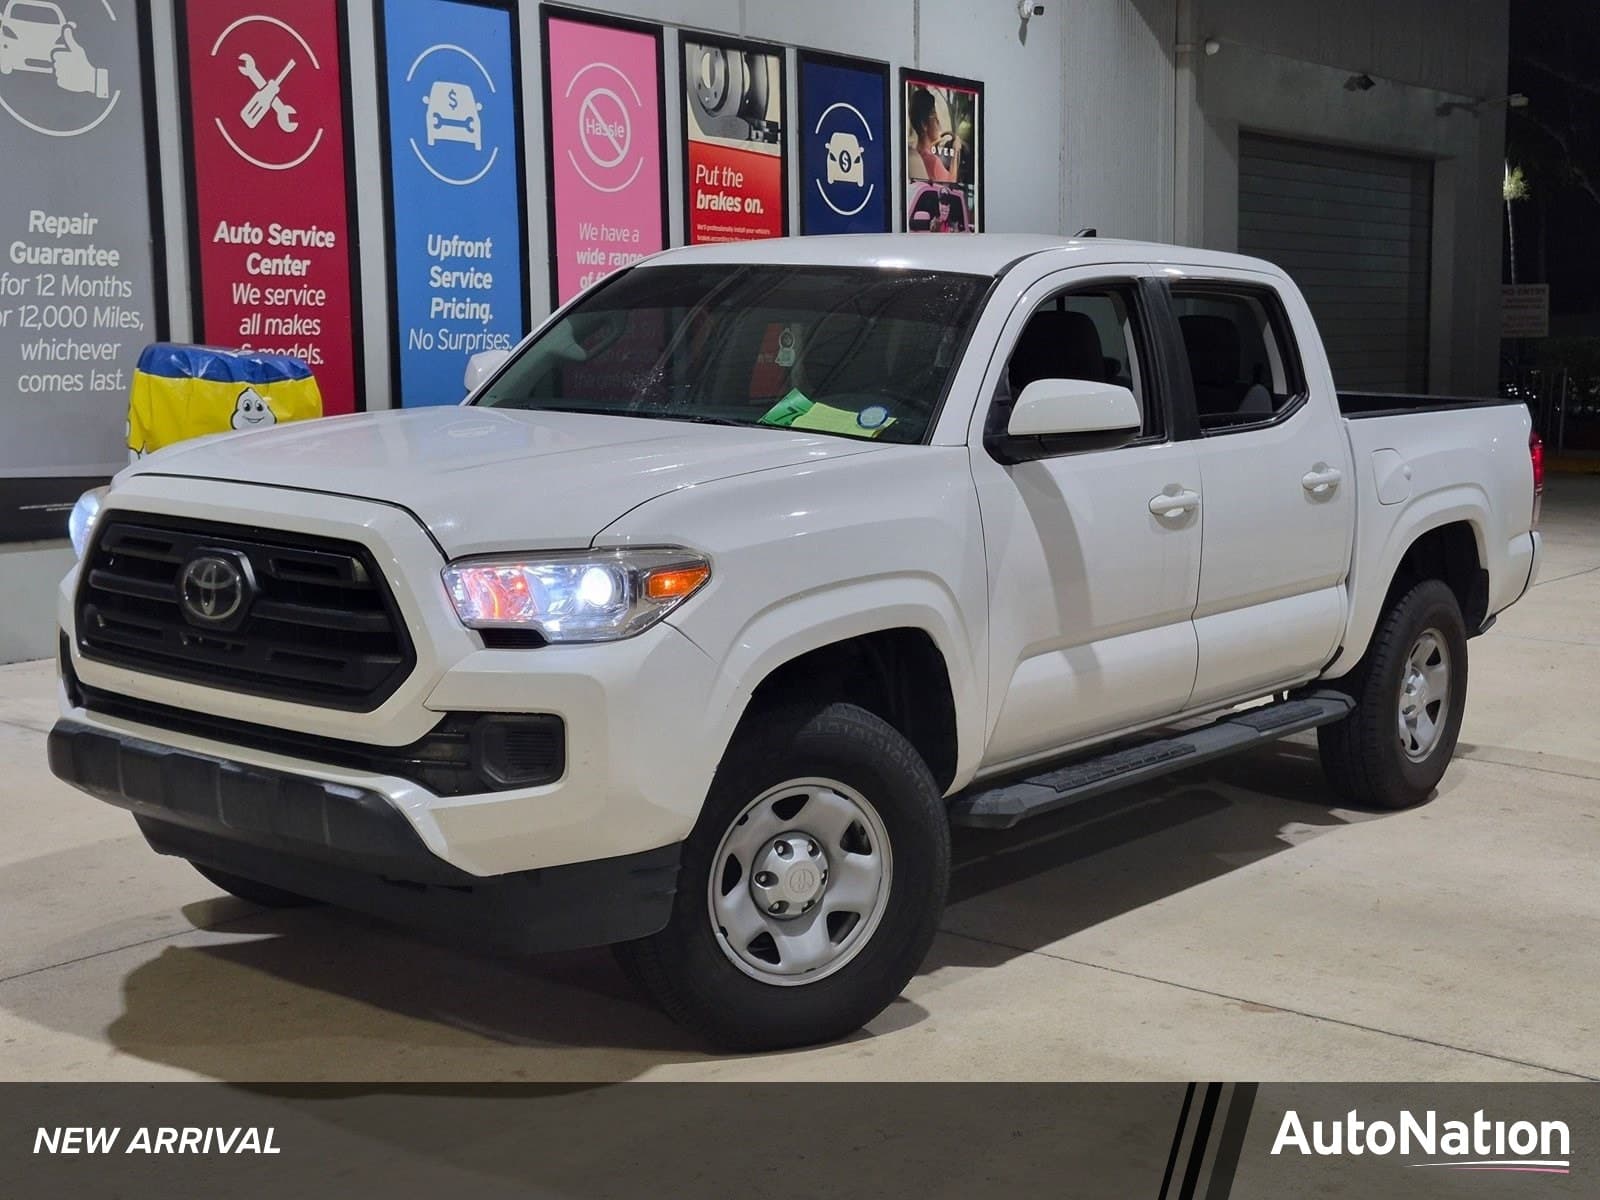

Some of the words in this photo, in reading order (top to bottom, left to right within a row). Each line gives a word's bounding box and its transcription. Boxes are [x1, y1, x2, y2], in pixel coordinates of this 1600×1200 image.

[695, 164, 719, 186] Put
[721, 166, 743, 188] the
[696, 189, 742, 212] brakes
[744, 198, 764, 214] on.
[29, 210, 98, 239] Repair
[213, 220, 263, 245] Auto
[267, 223, 335, 248] Service
[579, 222, 599, 241] We
[600, 224, 630, 242] have
[632, 229, 640, 243] a
[10, 241, 120, 267] Guarantee
[427, 233, 493, 261] Upfront
[576, 247, 606, 265] wide
[246, 252, 311, 277] Center
[429, 265, 493, 289] Service
[0, 271, 31, 296] for
[35, 273, 56, 297] 12
[61, 274, 132, 298] Months
[232, 282, 260, 306] We
[264, 285, 326, 306] service
[18, 304, 87, 331] 12,000
[93, 306, 145, 330] Miles,
[430, 297, 494, 325] Pricing.
[239, 313, 260, 335] all
[265, 315, 321, 336] makes
[21, 339, 121, 361] whichever
[408, 328, 434, 351] No
[437, 328, 513, 355] Surprises.
[18, 374, 83, 392] comes
[90, 368, 126, 391] last.
